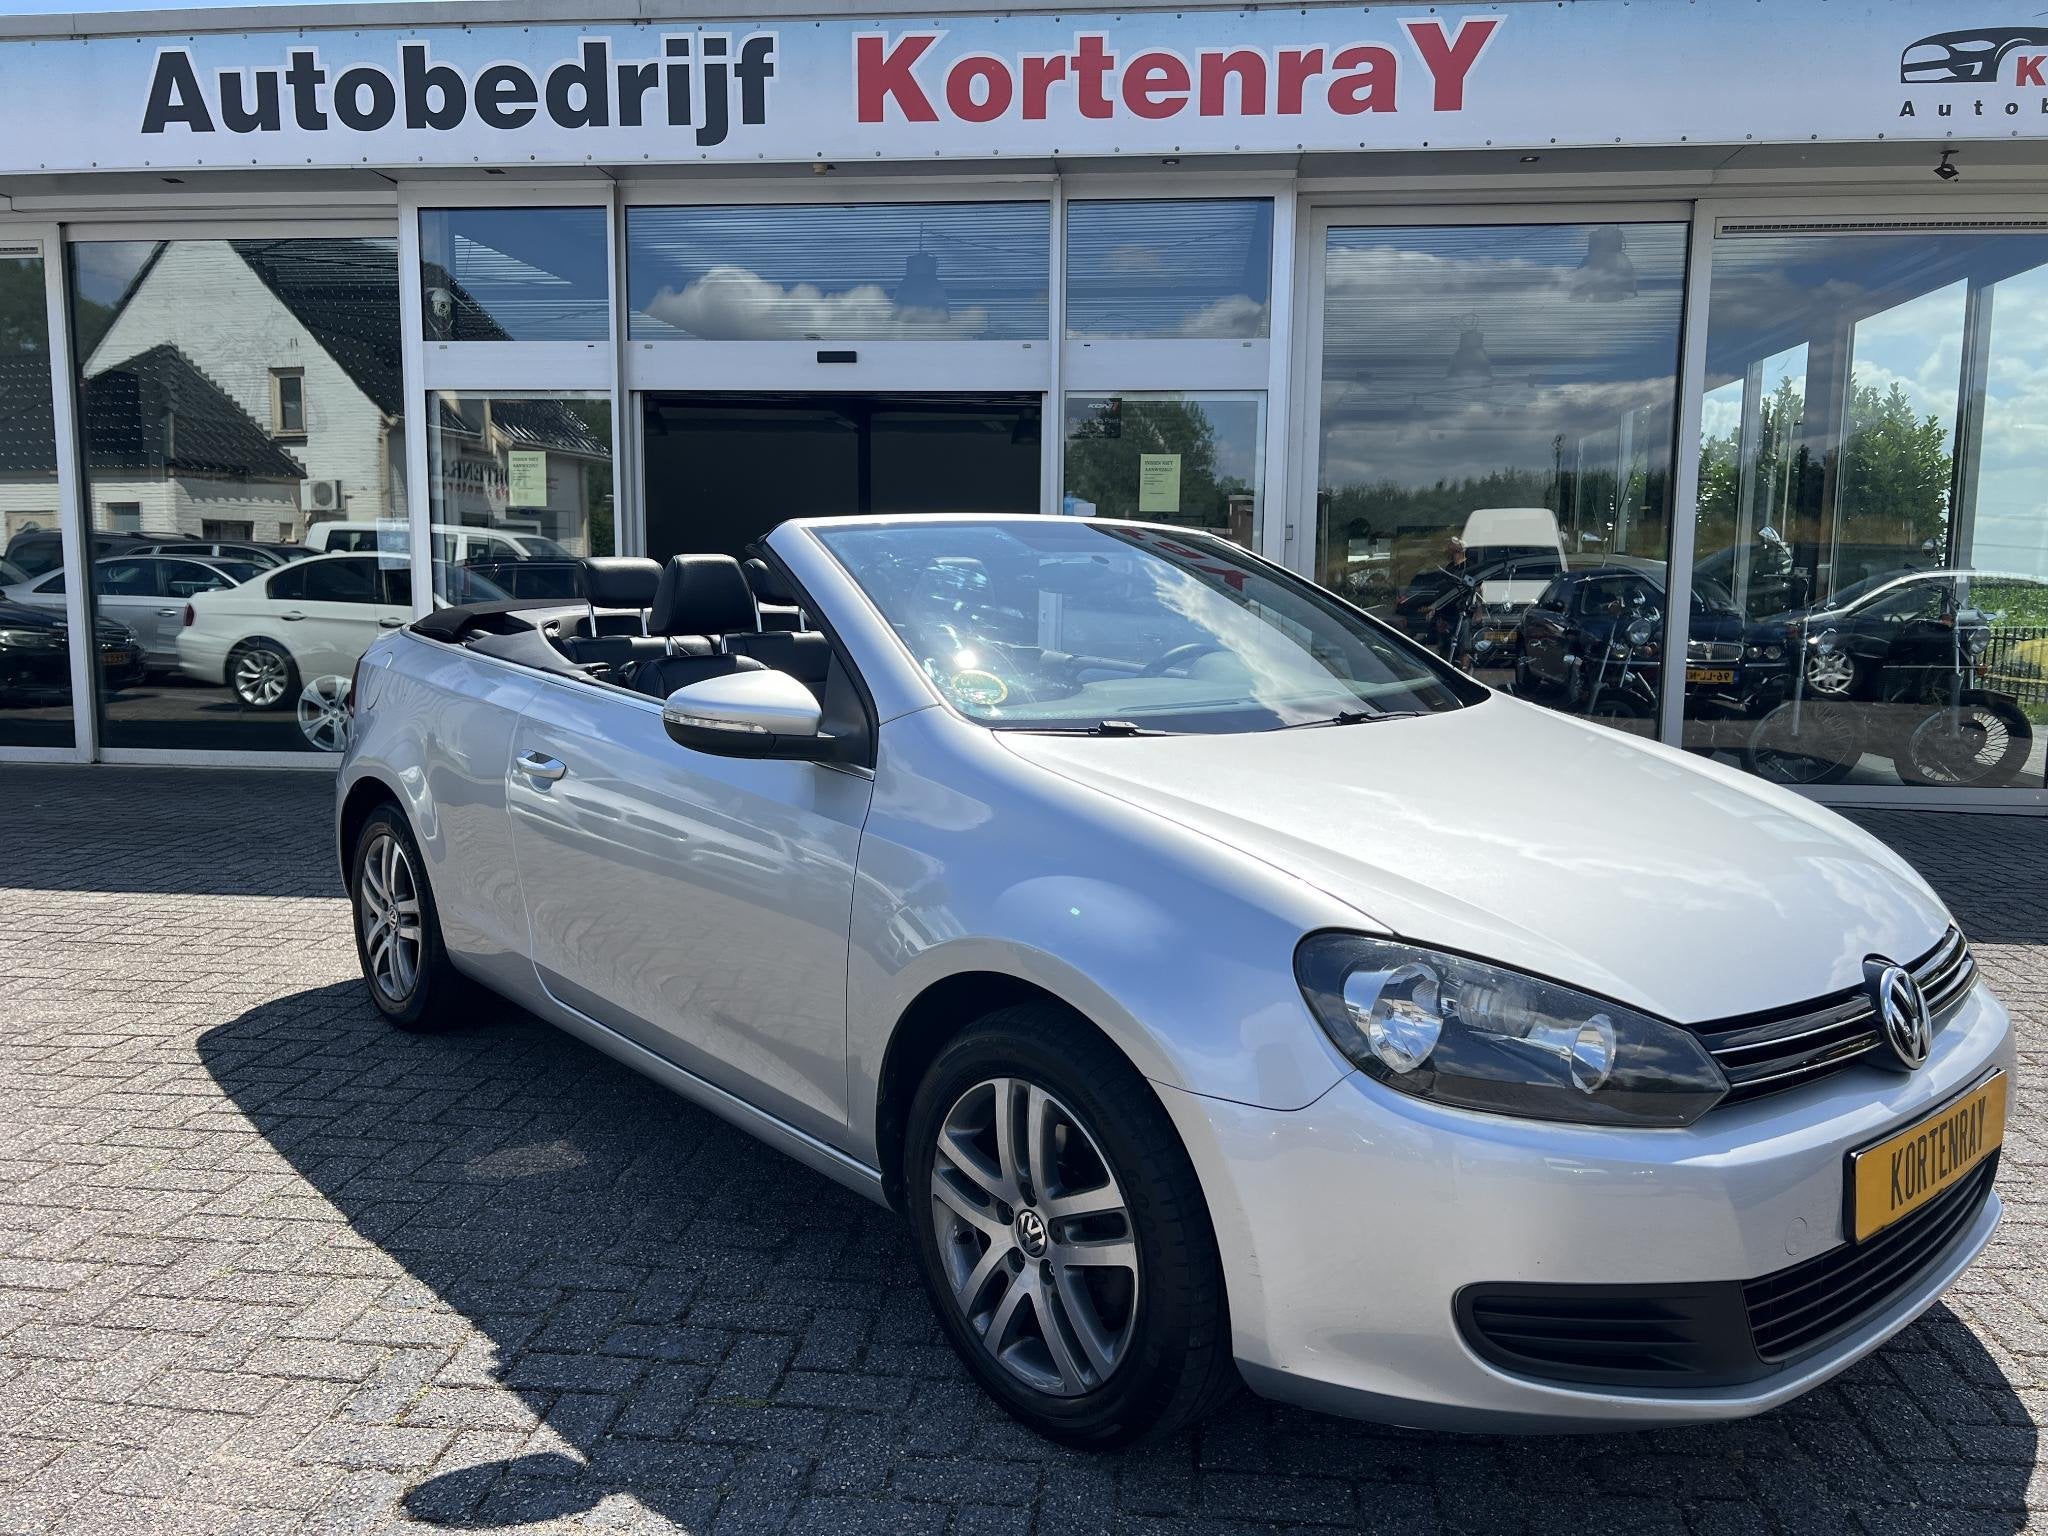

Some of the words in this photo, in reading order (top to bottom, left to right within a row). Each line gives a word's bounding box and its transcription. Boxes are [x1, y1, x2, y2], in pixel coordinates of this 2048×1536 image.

[141, 37, 774, 147] Autobedrijf
[857, 20, 1499, 123] KortenraY
[1890, 1096, 1987, 1211] KORTENRAY
